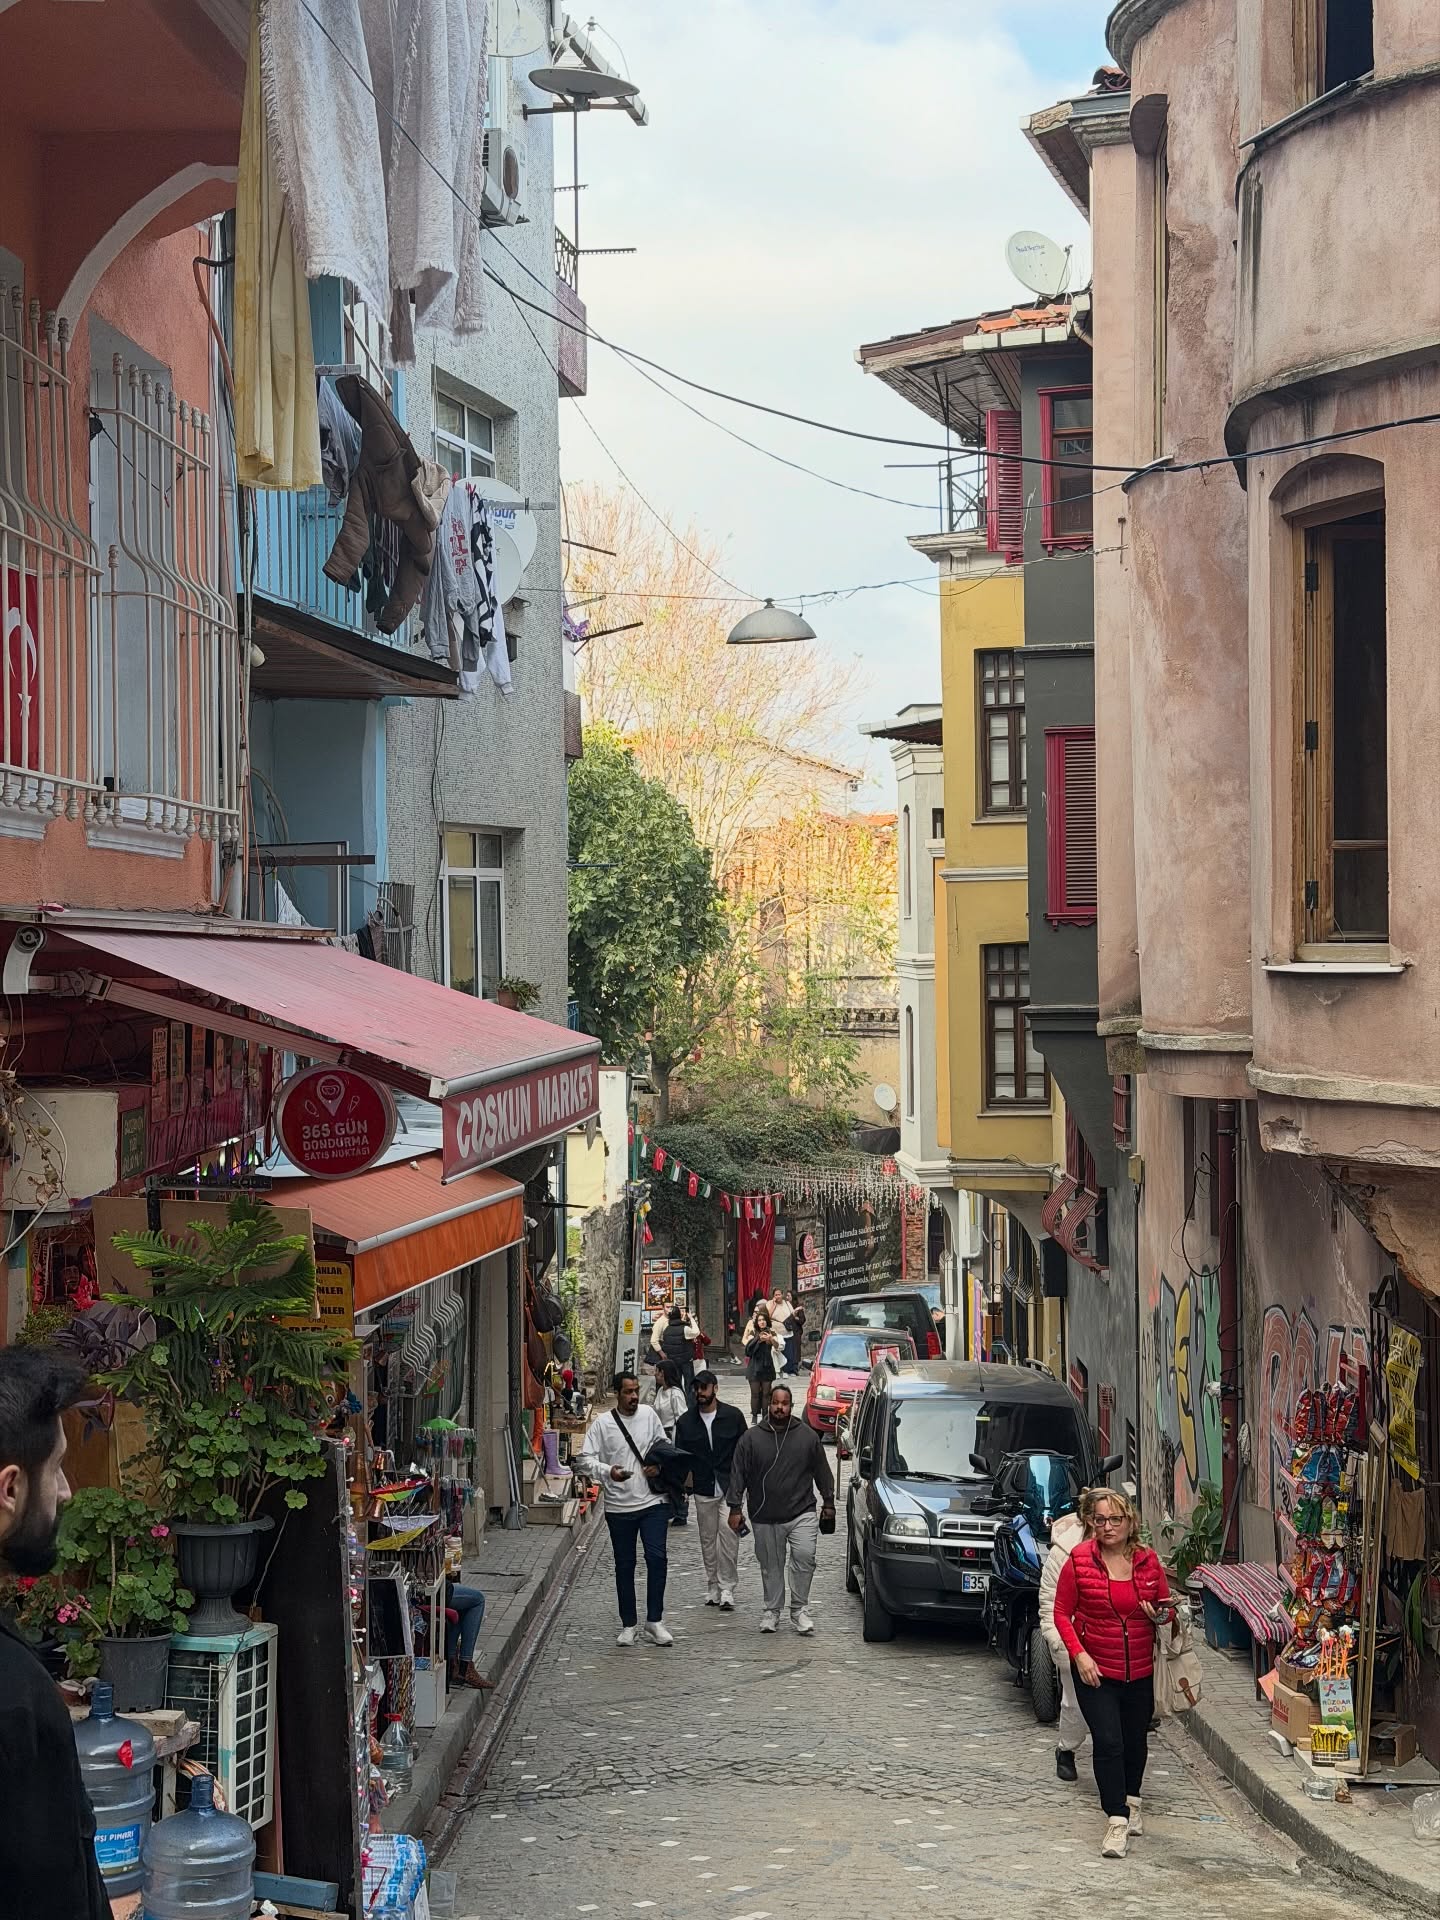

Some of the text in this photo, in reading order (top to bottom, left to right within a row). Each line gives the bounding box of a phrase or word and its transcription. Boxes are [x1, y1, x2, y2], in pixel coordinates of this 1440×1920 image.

[537, 1064, 593, 1129] MARKET
[302, 1118, 368, 1140] 365 GÜN
[302, 1135, 370, 1151] DONDURMA
[970, 1575, 985, 1590] 35
